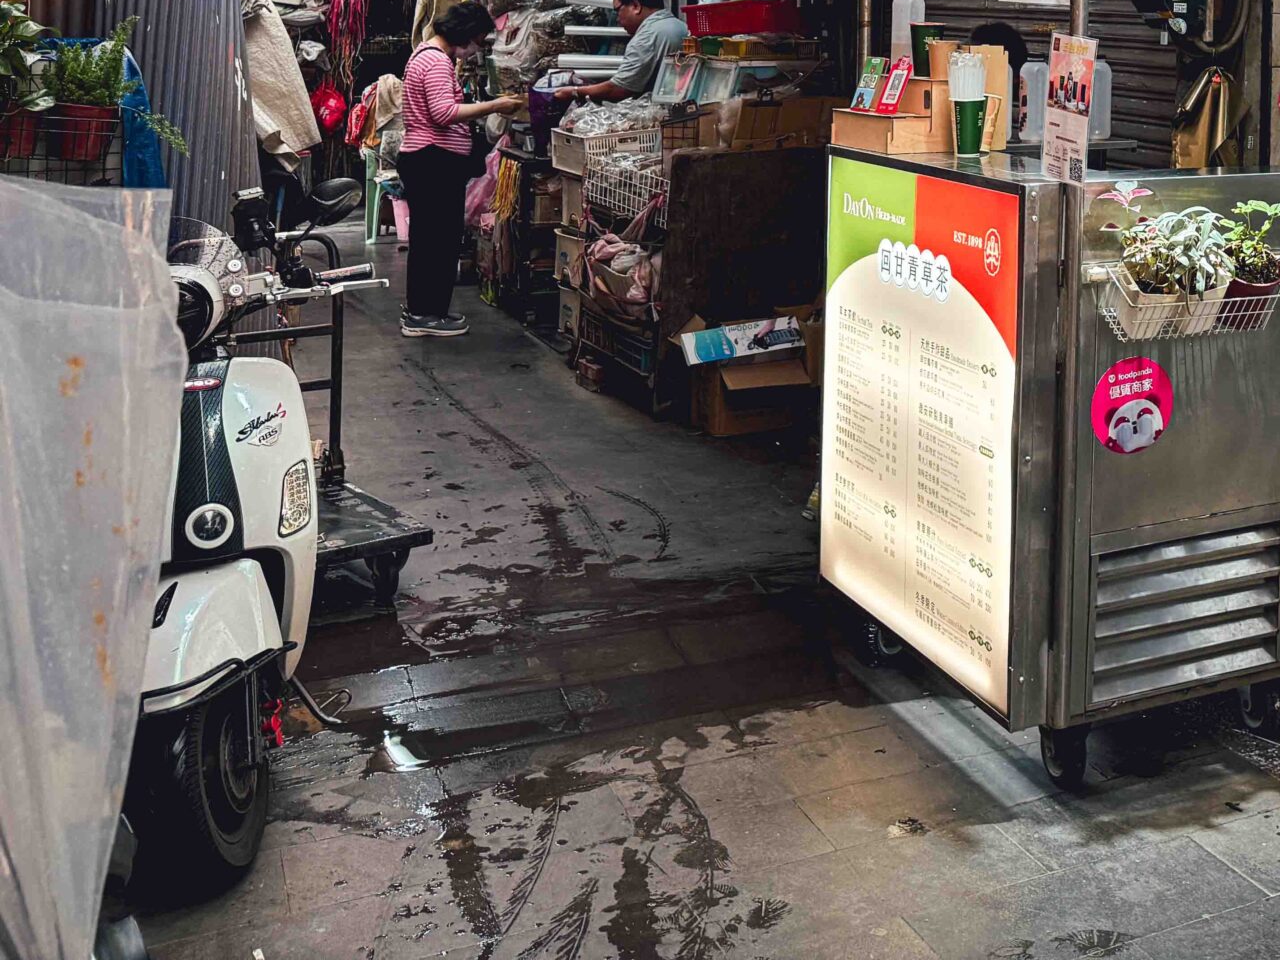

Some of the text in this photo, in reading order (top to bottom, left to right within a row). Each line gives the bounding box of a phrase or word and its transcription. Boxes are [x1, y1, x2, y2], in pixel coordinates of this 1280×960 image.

[881, 249, 949, 293] 回甘青草茶
[1118, 367, 1152, 380] foodpanda
[1109, 379, 1153, 399] 優質商家
[258, 427, 278, 443] ABS
